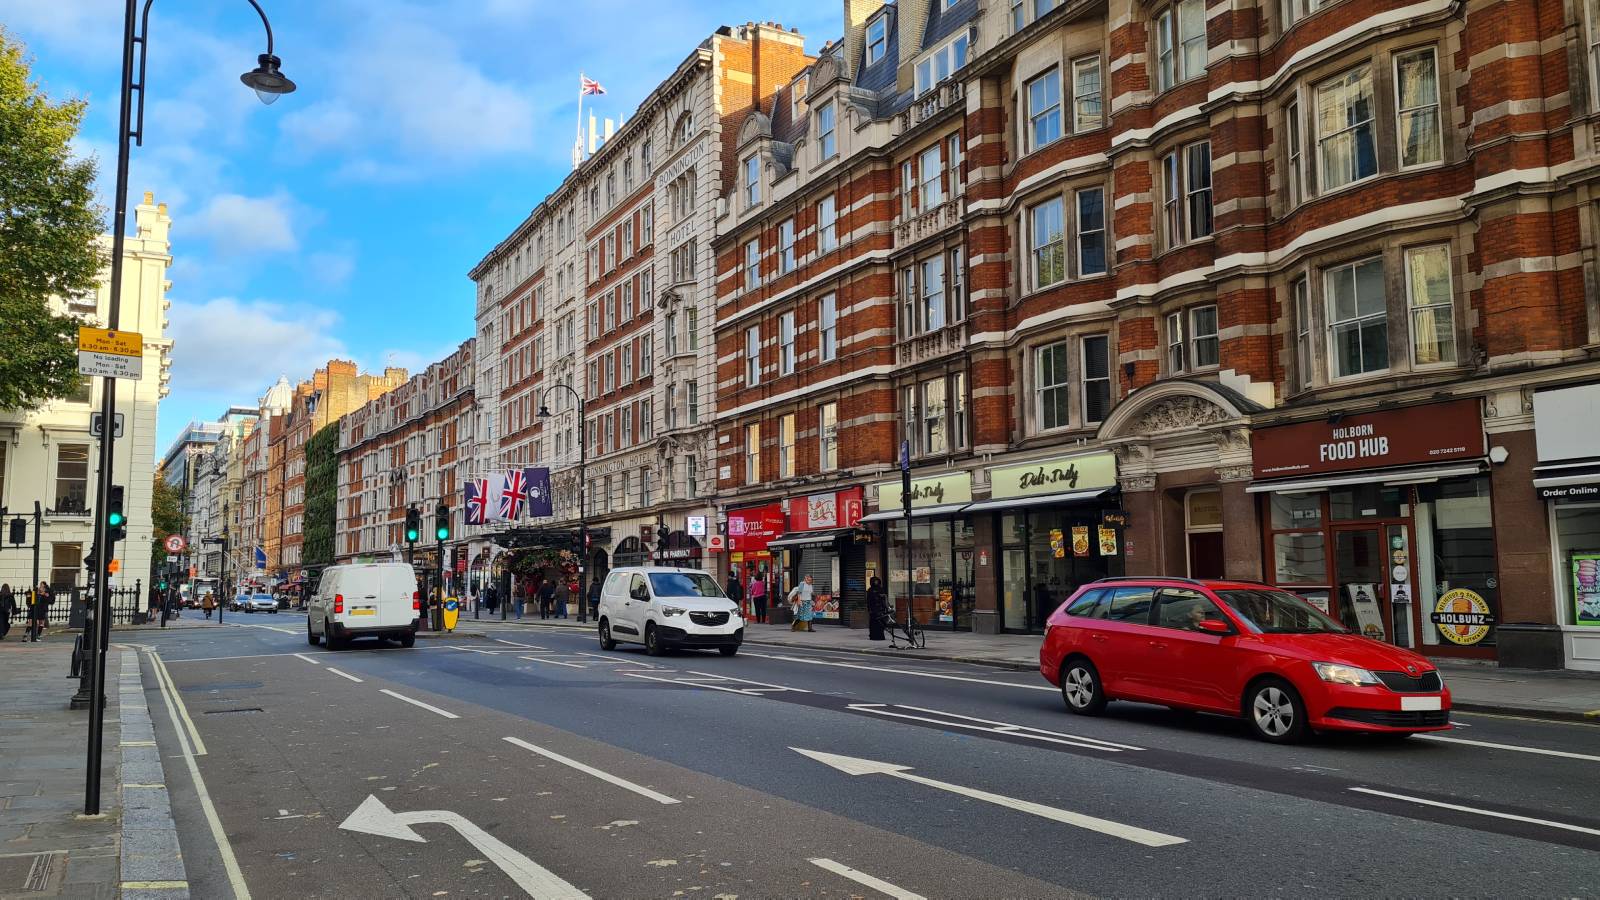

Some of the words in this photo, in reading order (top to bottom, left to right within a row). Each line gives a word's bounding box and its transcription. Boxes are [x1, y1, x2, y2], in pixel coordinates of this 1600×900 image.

[659, 141, 704, 186] BONNINGTON
[670, 220, 696, 245] HOTEL
[105, 355, 129, 363] loading
[1332, 423, 1374, 440] HOLBORN
[1320, 441, 1357, 462] FOOD
[1360, 436, 1389, 457] HUB
[586, 459, 625, 478] BONNINGTON
[630, 452, 651, 467] HOTEL
[1570, 486, 1598, 495] Online
[669, 549, 690, 558] PHARMACY
[1440, 614, 1485, 624] HOLBUNZ
